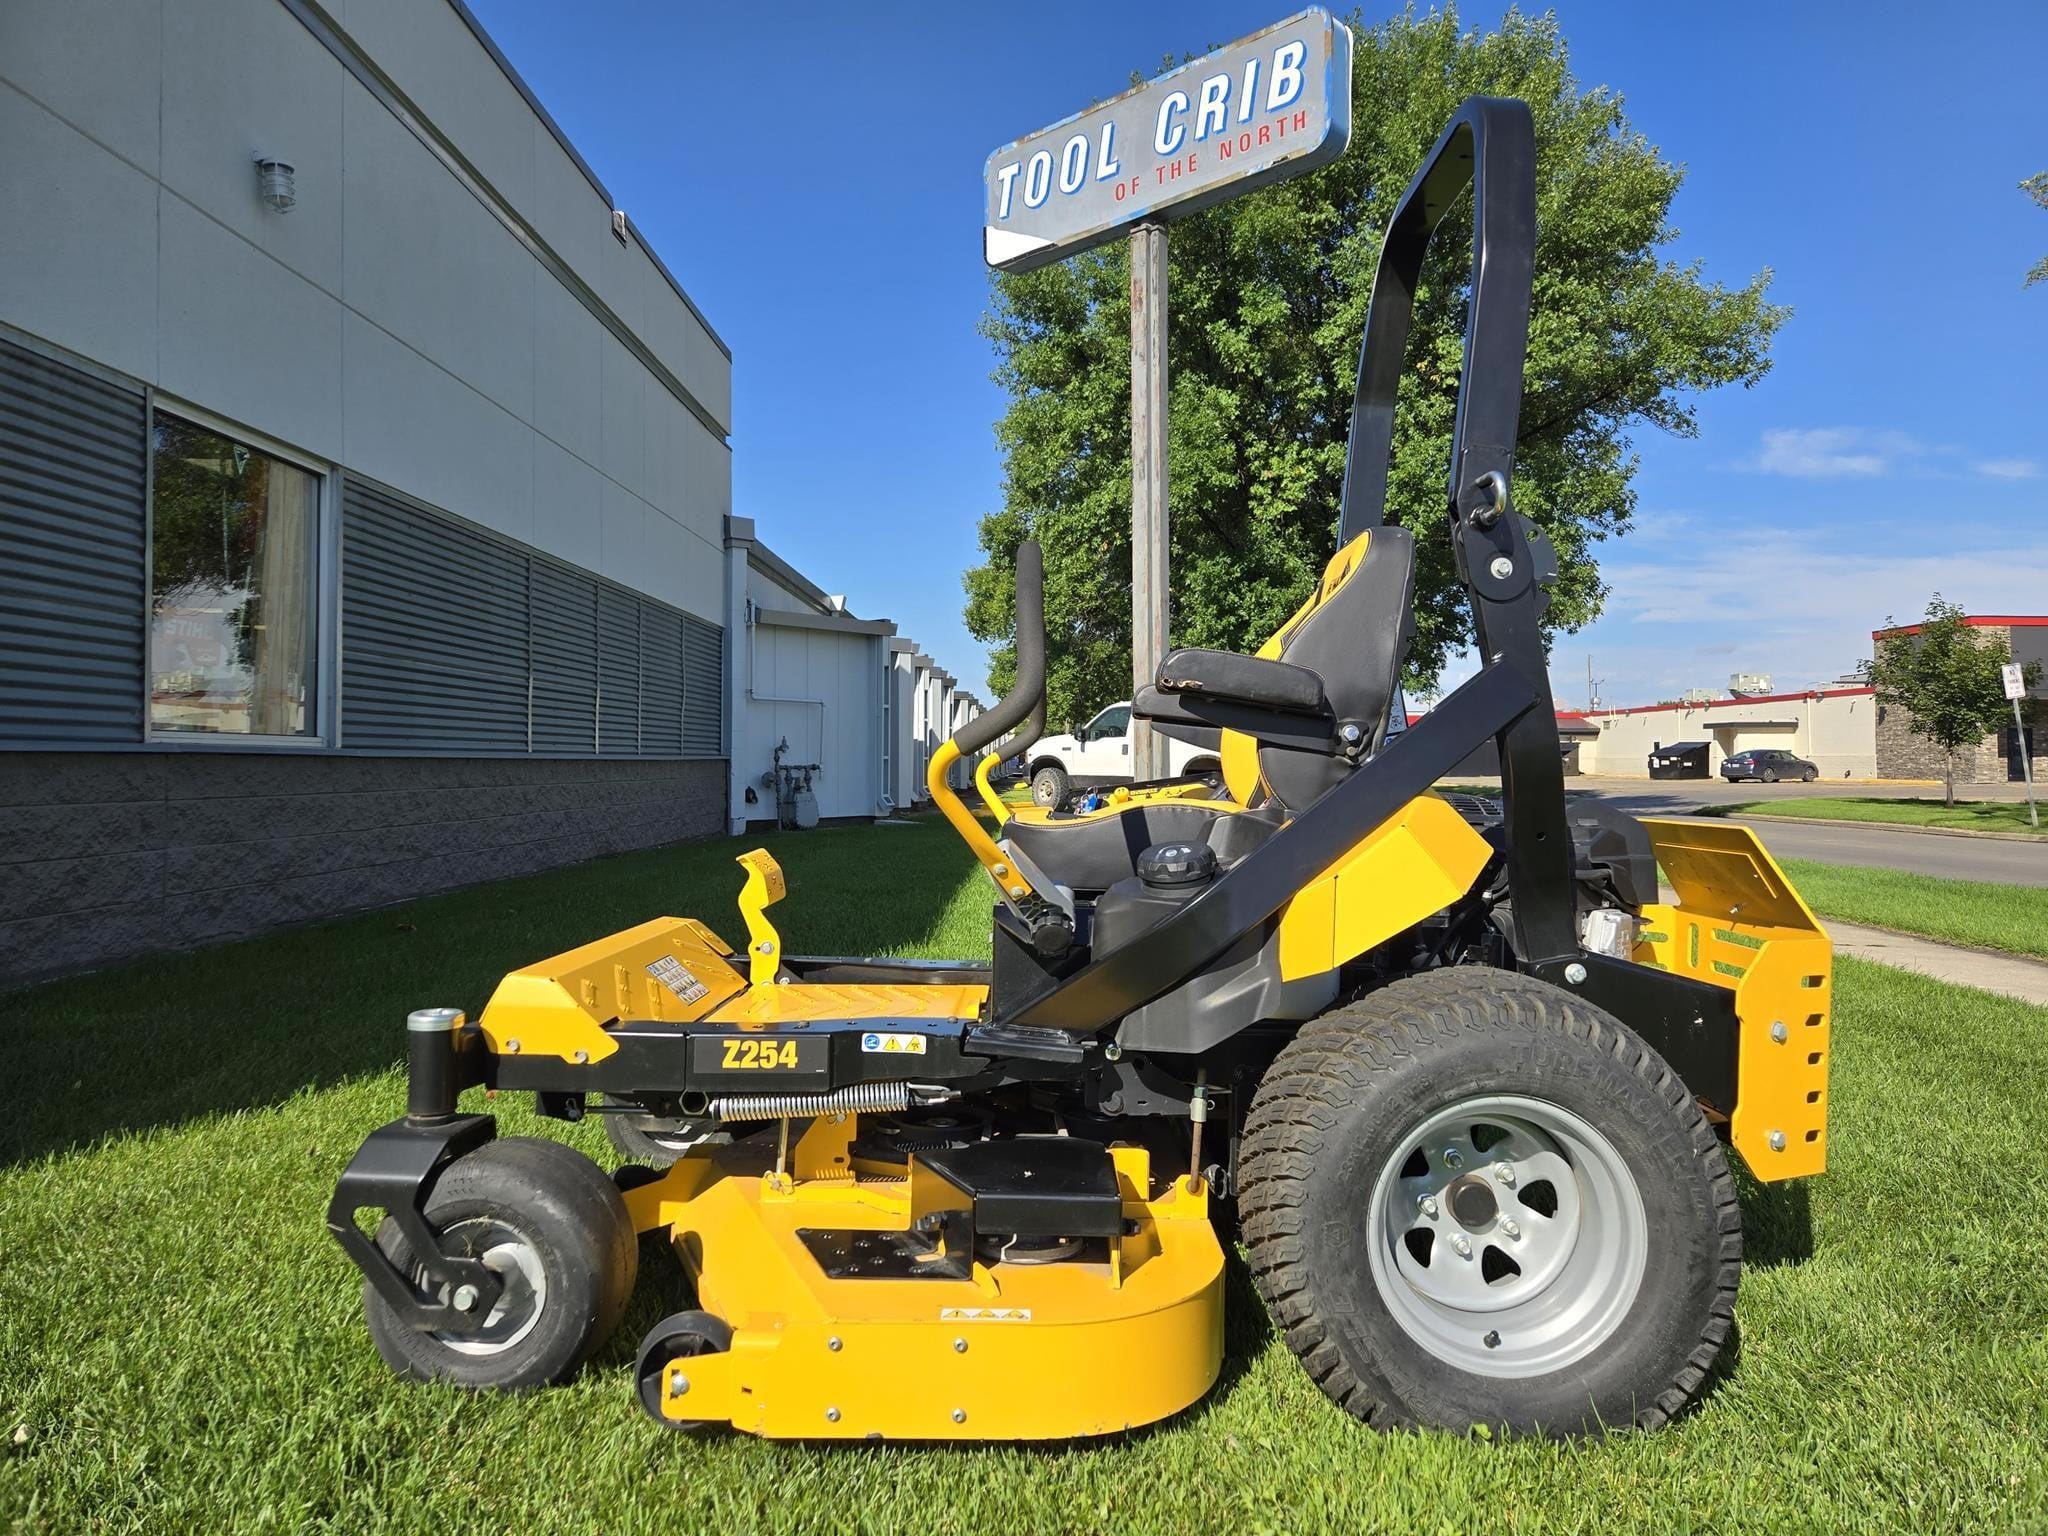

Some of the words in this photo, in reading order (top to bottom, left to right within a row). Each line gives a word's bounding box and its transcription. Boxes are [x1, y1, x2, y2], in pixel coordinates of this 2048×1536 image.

[997, 120, 1121, 219] TOOL
[1154, 40, 1307, 155] CRIB
[1114, 175, 1140, 202] OF
[1156, 153, 1198, 185] THE
[1219, 110, 1307, 162] NORTH
[722, 1040, 798, 1069] Z254
